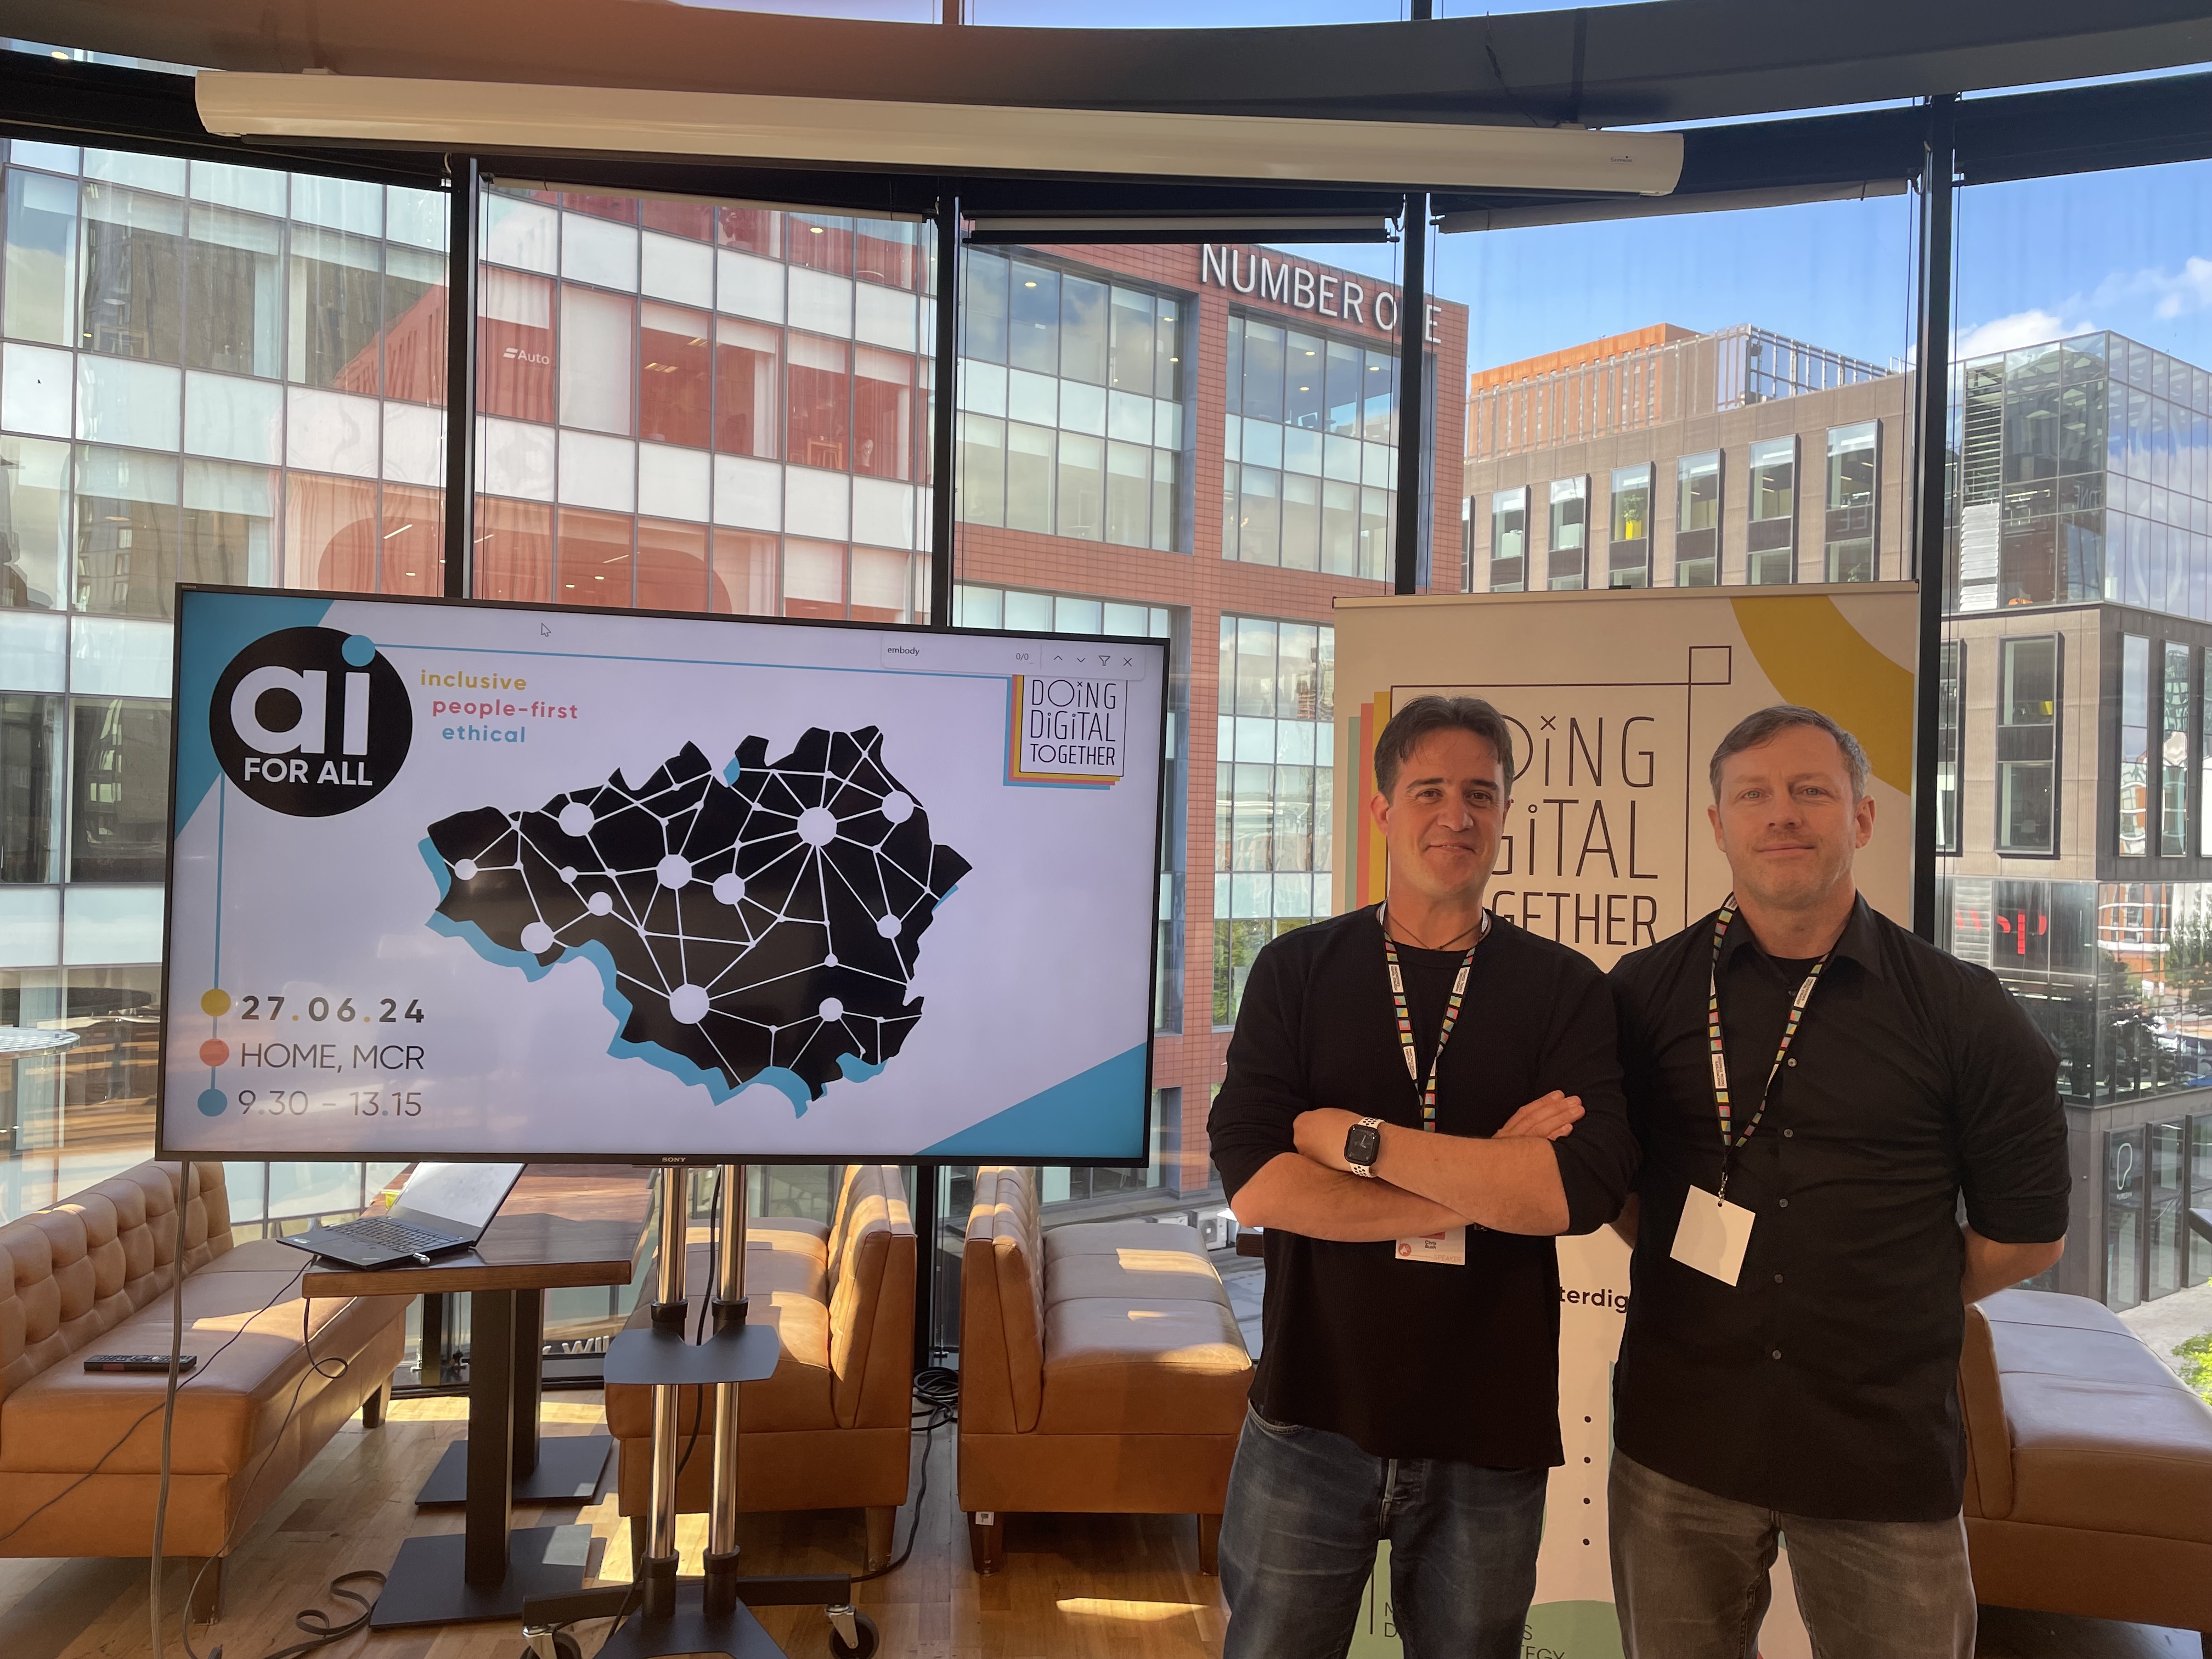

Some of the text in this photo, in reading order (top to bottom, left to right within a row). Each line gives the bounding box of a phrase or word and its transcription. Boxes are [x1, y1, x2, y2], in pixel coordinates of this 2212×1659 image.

[1202, 244, 1442, 344] NUMBER OE
[517, 349, 550, 365] Auto
[887, 646, 1029, 661] embody 0/0
[421, 669, 527, 691] inclusive
[432, 699, 578, 720] people-first
[442, 725, 526, 743] ethical
[1030, 743, 1115, 766] TOGETHER
[244, 757, 373, 786] FOR ALL
[1492, 890, 1657, 946] GETHER
[241, 1043, 424, 1073] HOME, MCR
[239, 1090, 308, 1115] 9.30
[349, 1091, 422, 1116] 13.15
